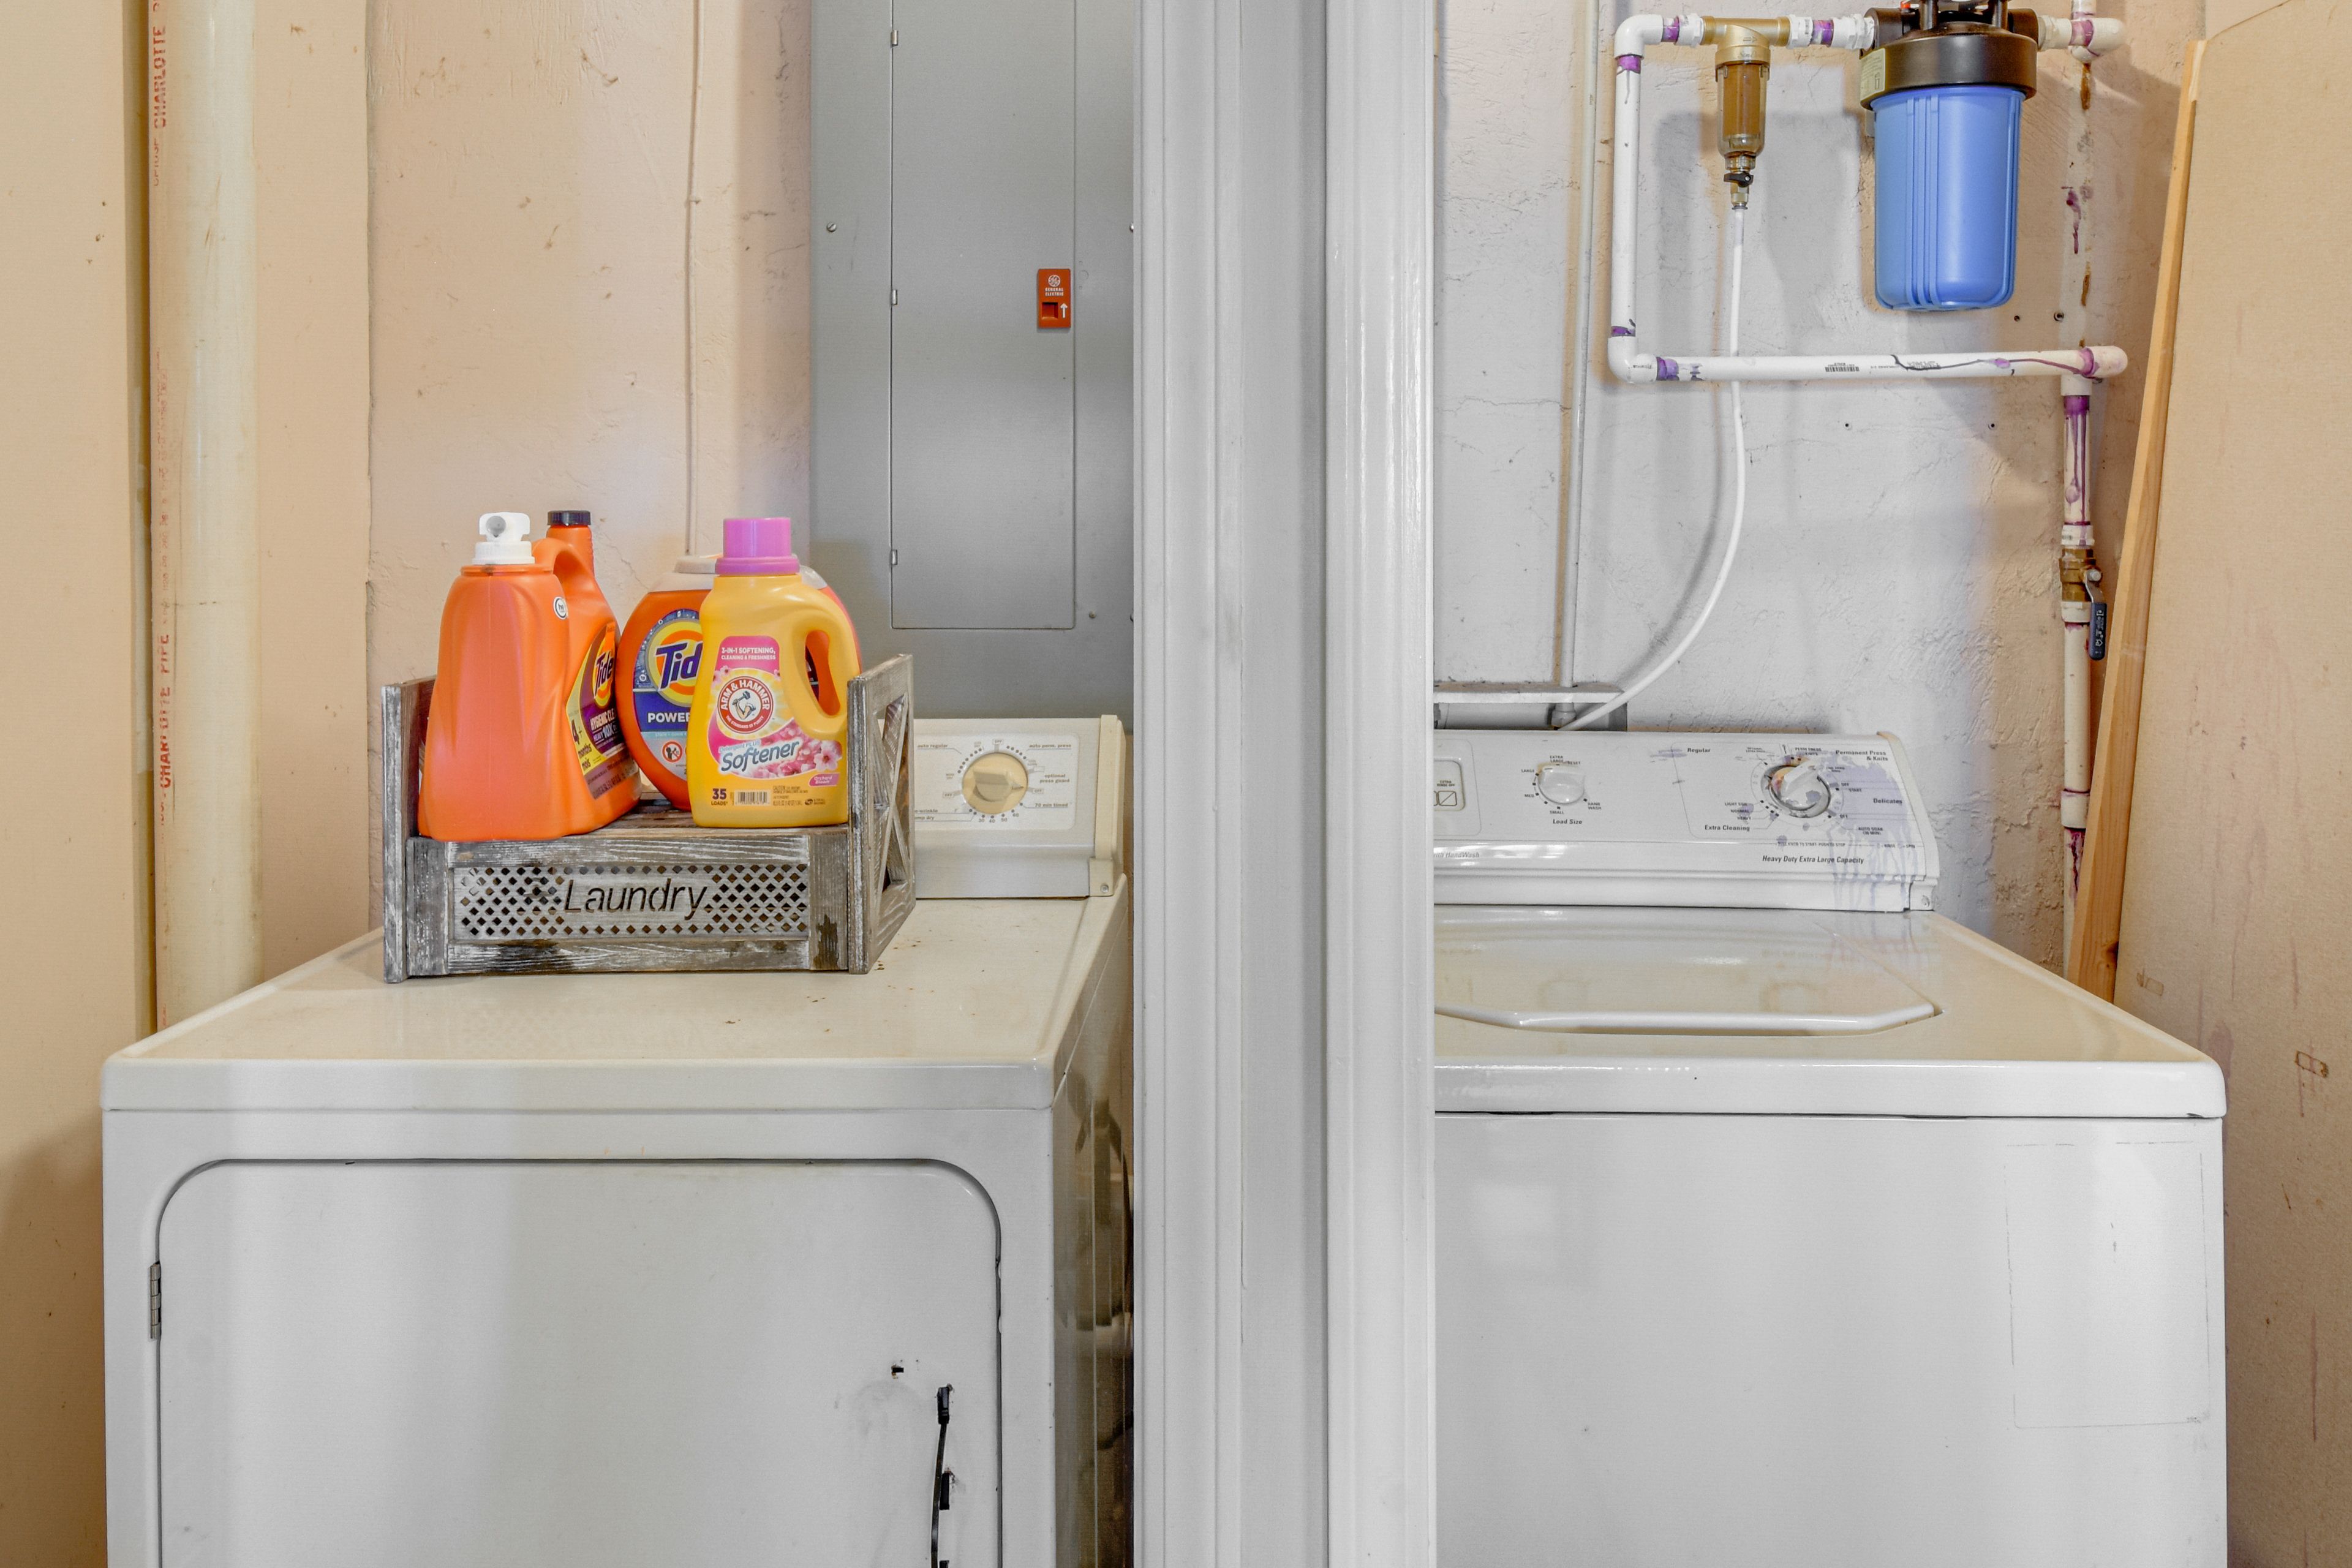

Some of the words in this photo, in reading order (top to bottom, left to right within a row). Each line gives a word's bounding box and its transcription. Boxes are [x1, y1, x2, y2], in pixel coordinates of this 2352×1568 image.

[153, 26, 166, 129] CHARLOTTE
[593, 651, 614, 700] Tide
[656, 642, 703, 690] Tid
[720, 688, 733, 710] ARM
[731, 682, 739, 692] &
[739, 679, 771, 710] HAMMER
[720, 741, 800, 772] Softener
[745, 740, 761, 748] PLUS
[712, 788, 727, 800] 35
[563, 877, 709, 921] Laundry
